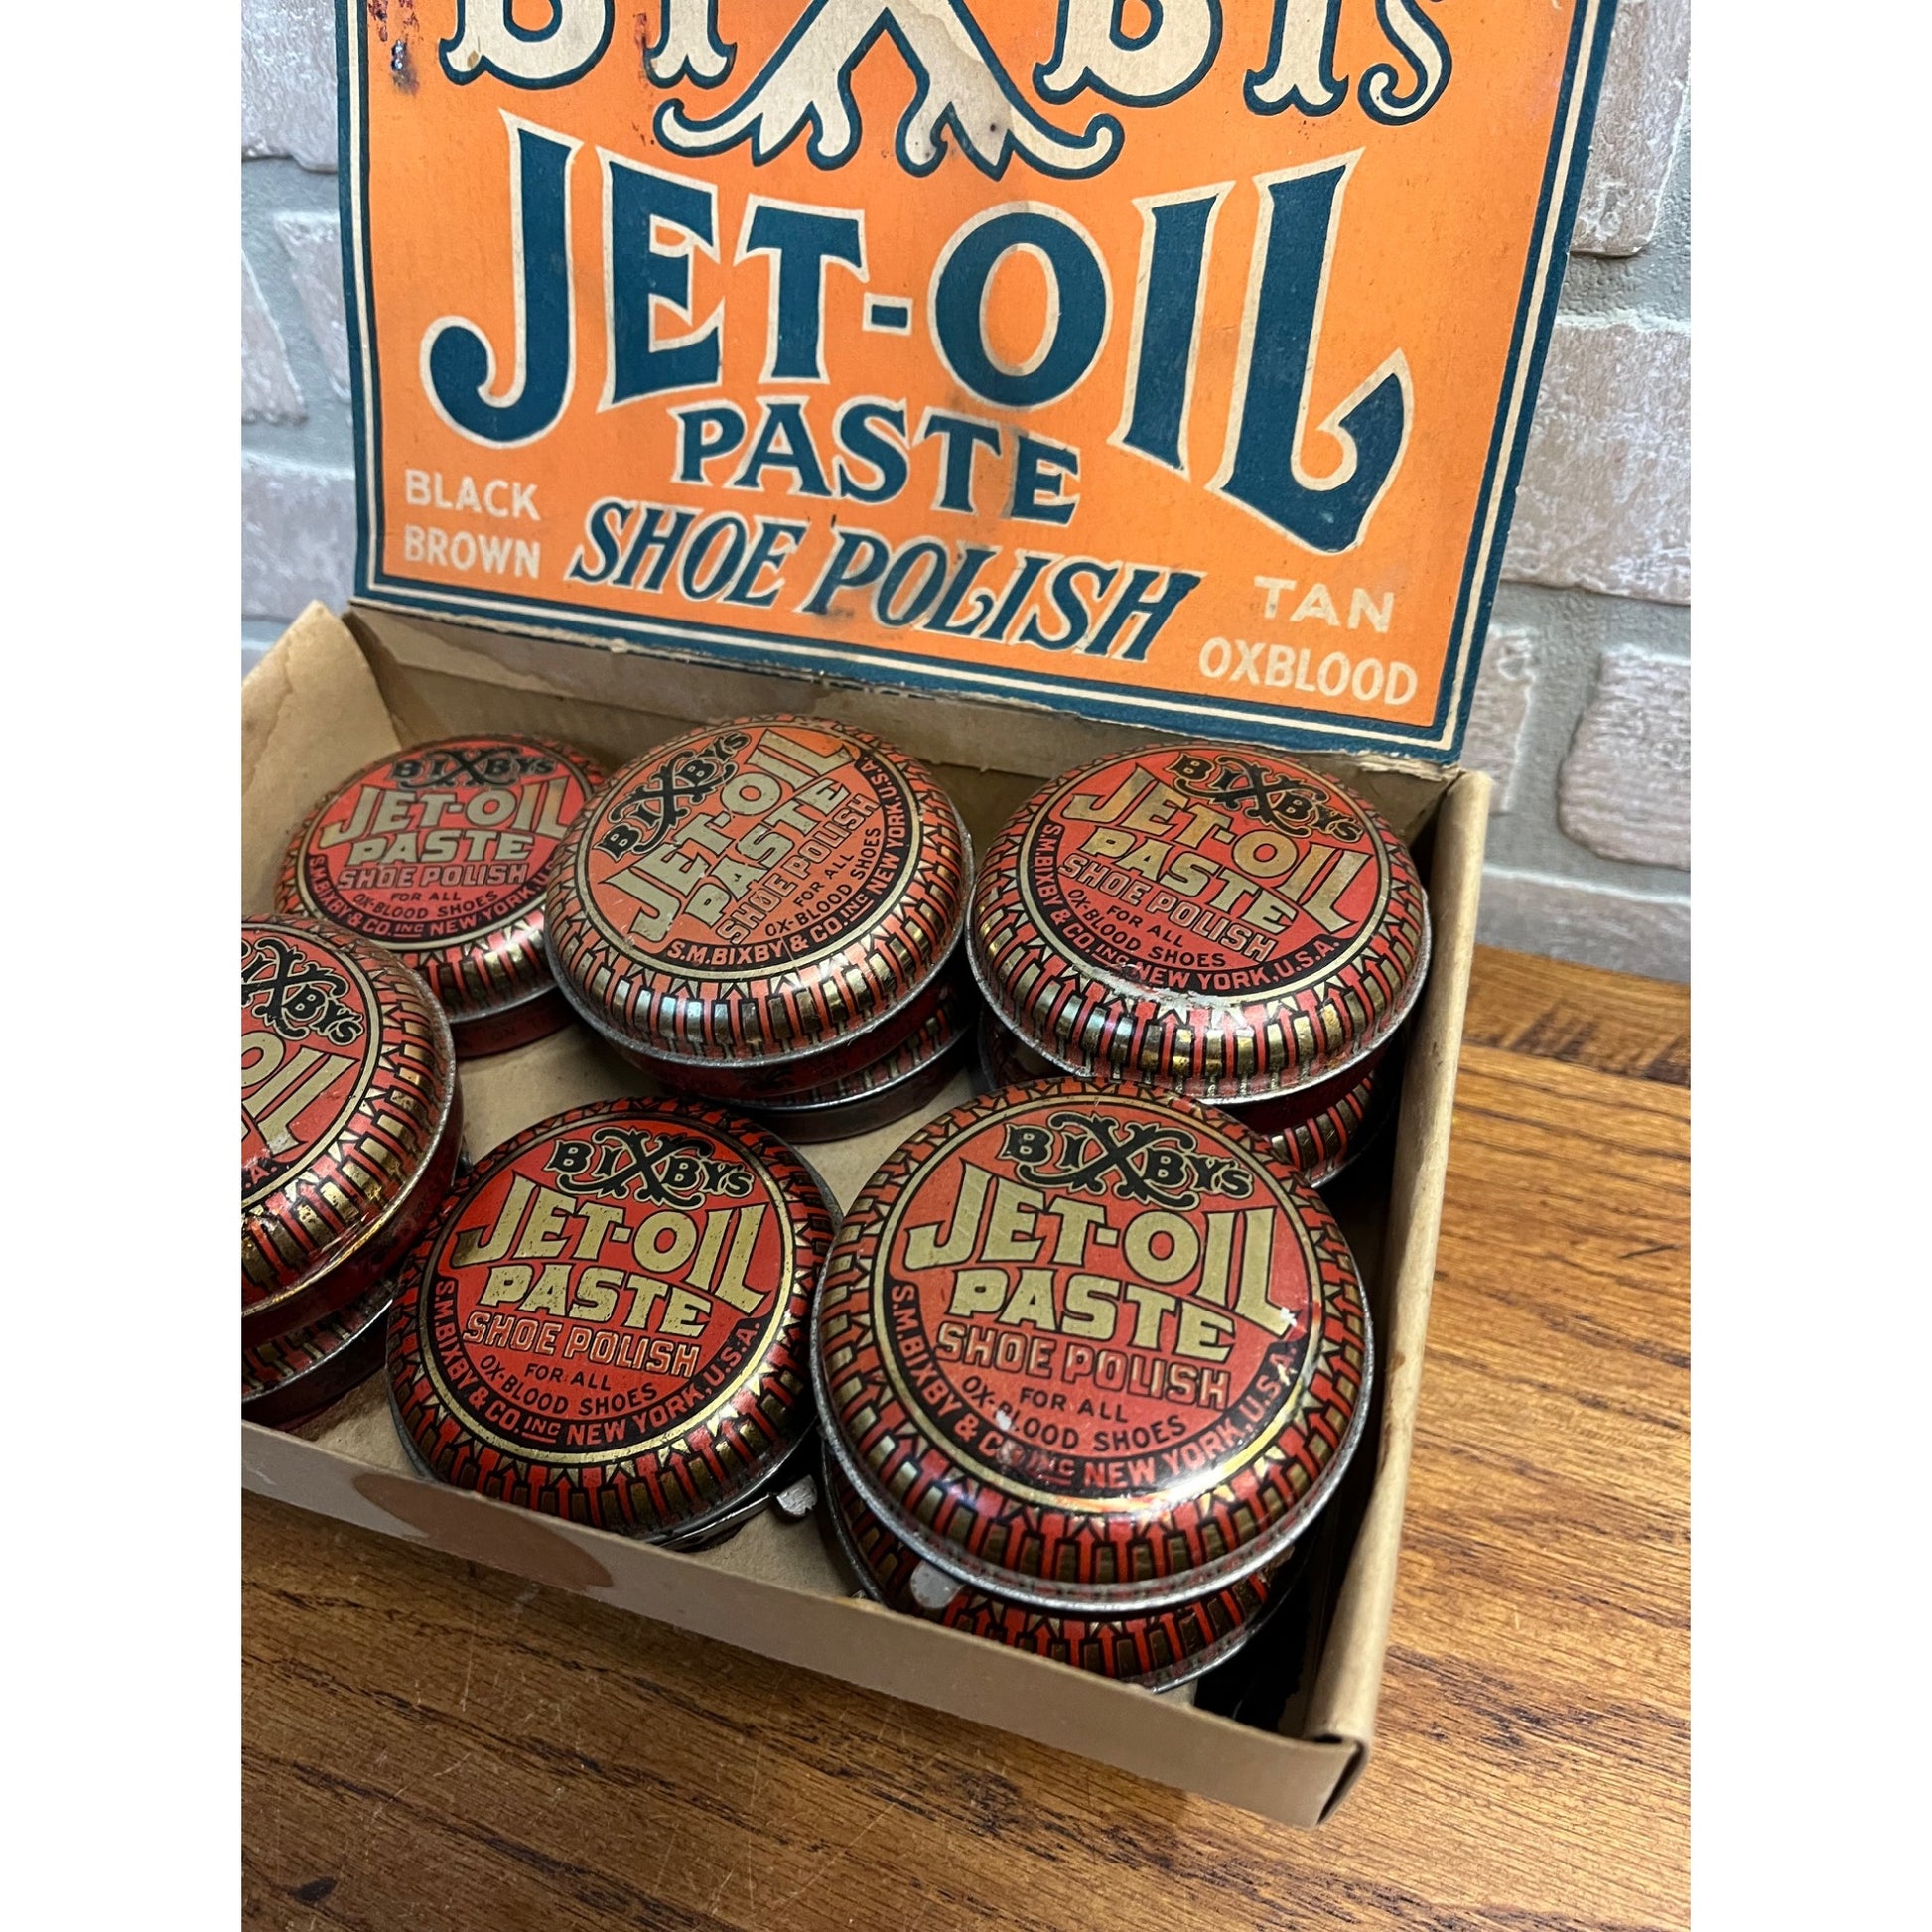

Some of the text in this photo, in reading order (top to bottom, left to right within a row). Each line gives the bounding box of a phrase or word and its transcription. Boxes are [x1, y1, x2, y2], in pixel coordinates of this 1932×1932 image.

[419, 107, 1414, 556] JET-OIL
[405, 469, 542, 521] BLACK
[666, 394, 1079, 526] PASTE
[405, 530, 541, 579] BROWN
[564, 496, 1208, 663] SHOE POLISH
[1253, 575, 1395, 633] TAN
[1199, 636, 1418, 707] OXBLOOD
[319, 775, 572, 848] JET-OIL
[347, 828, 533, 866] PASTE
[598, 728, 857, 943] JET-OIL
[1061, 763, 1374, 934] JET-OIL
[337, 866, 417, 890] SHOE
[419, 864, 528, 887] POLISH
[682, 777, 851, 928] PASTE
[716, 793, 881, 945] SHOE POLISH
[765, 827, 881, 936] OX-BLOOD SHOES
[793, 853, 855, 907] FOR ALL
[1077, 826, 1298, 935] PASTE
[347, 913, 363, 927] &
[430, 915, 477, 936] NEW
[391, 892, 461, 902] FOR ALL
[438, 891, 498, 917] SHOES
[789, 935, 809, 952] &
[866, 852, 900, 895] NEW
[1057, 853, 1279, 962] SHOE POLISH
[1068, 889, 1226, 967] OX-BLOOD SHOES
[1107, 905, 1183, 947] FOR ALL
[1050, 909, 1071, 925] &
[1136, 961, 1190, 989] NEW
[450, 1171, 768, 1314] JET-OIL
[902, 1159, 1299, 1339] JET-OIL
[476, 1263, 712, 1337] PASTE
[945, 1266, 1237, 1364] PASTE
[462, 1311, 700, 1378] SHOE POLISH
[524, 1363, 611, 1391] FOR ALL
[934, 1321, 1231, 1412] SHOE POLISH
[468, 1386, 489, 1412] &
[566, 1419, 626, 1446] NEW
[480, 1354, 658, 1416] OX-BLOOD SHOES
[1020, 1387, 1128, 1423] FOR ALL
[954, 1413, 979, 1442] &
[1084, 1458, 1156, 1488] NEW
[1093, 1415, 1186, 1451] SHOES
